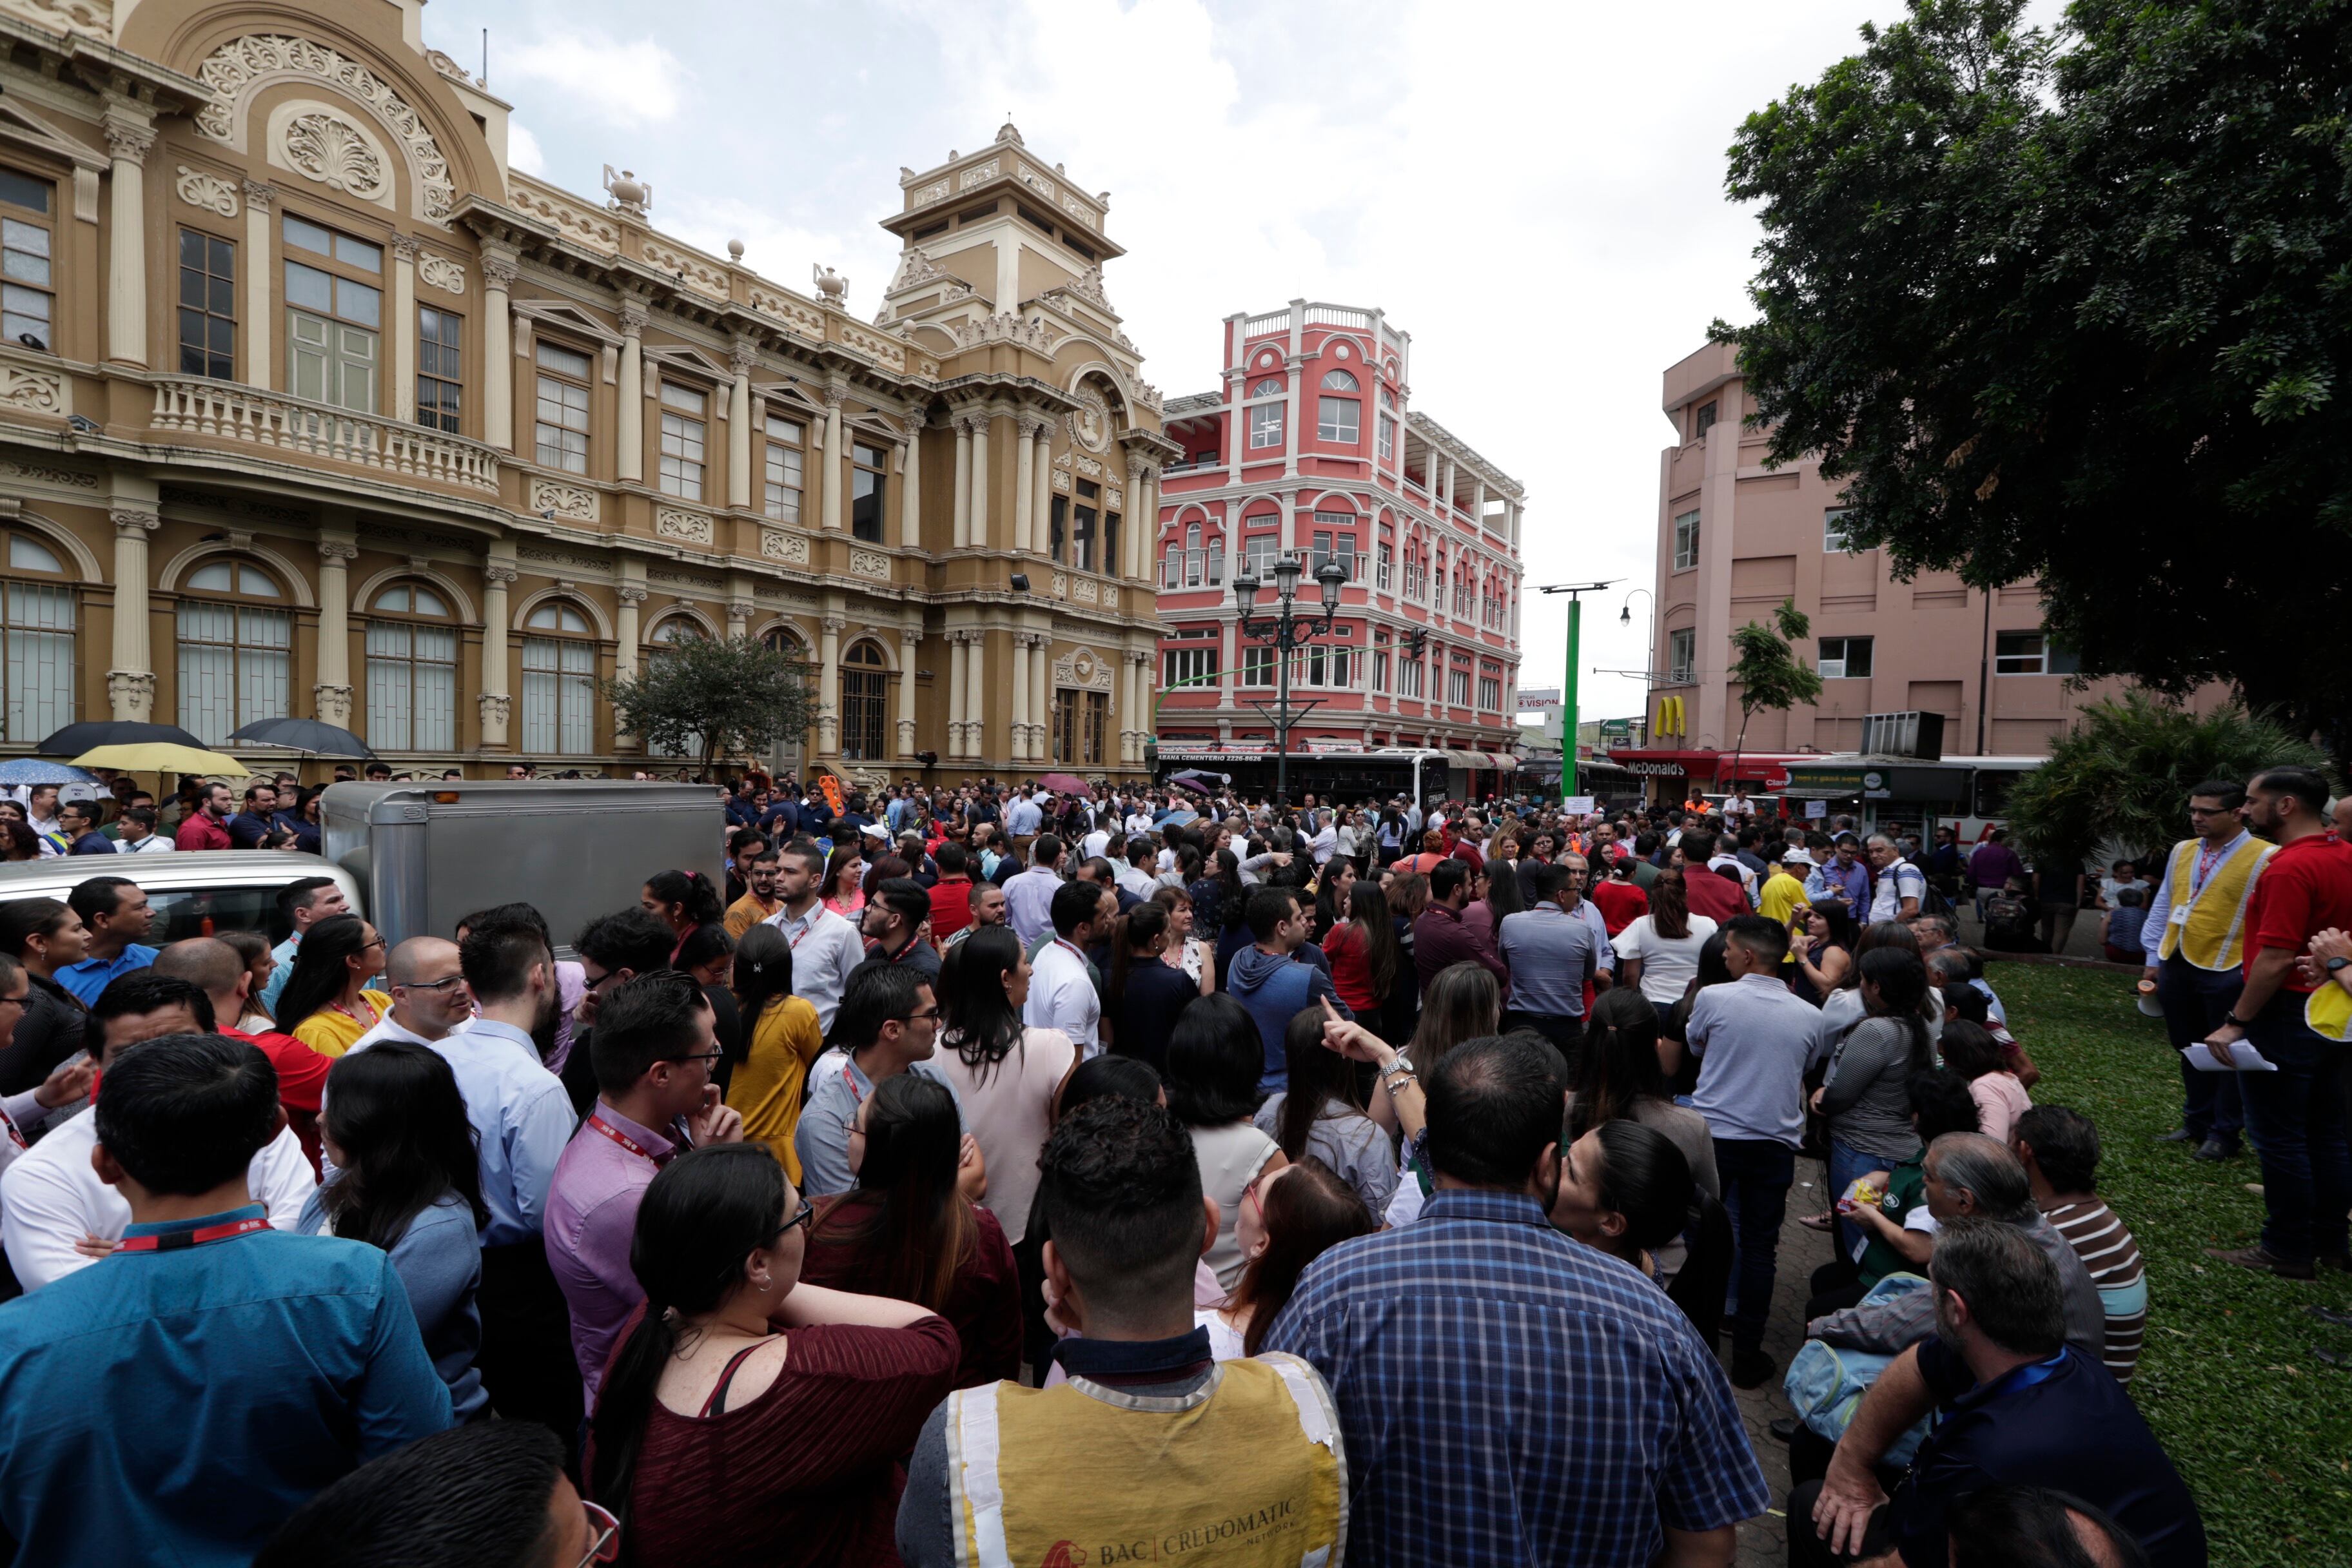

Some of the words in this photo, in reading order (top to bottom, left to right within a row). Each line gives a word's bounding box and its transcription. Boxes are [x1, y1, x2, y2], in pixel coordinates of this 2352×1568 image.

[1627, 761, 1685, 776] McDonald's
[1100, 1540, 1147, 1565] BAC
[1163, 1496, 1296, 1555] CREDOMATIC
[1246, 1518, 1295, 1547] NETWORK
